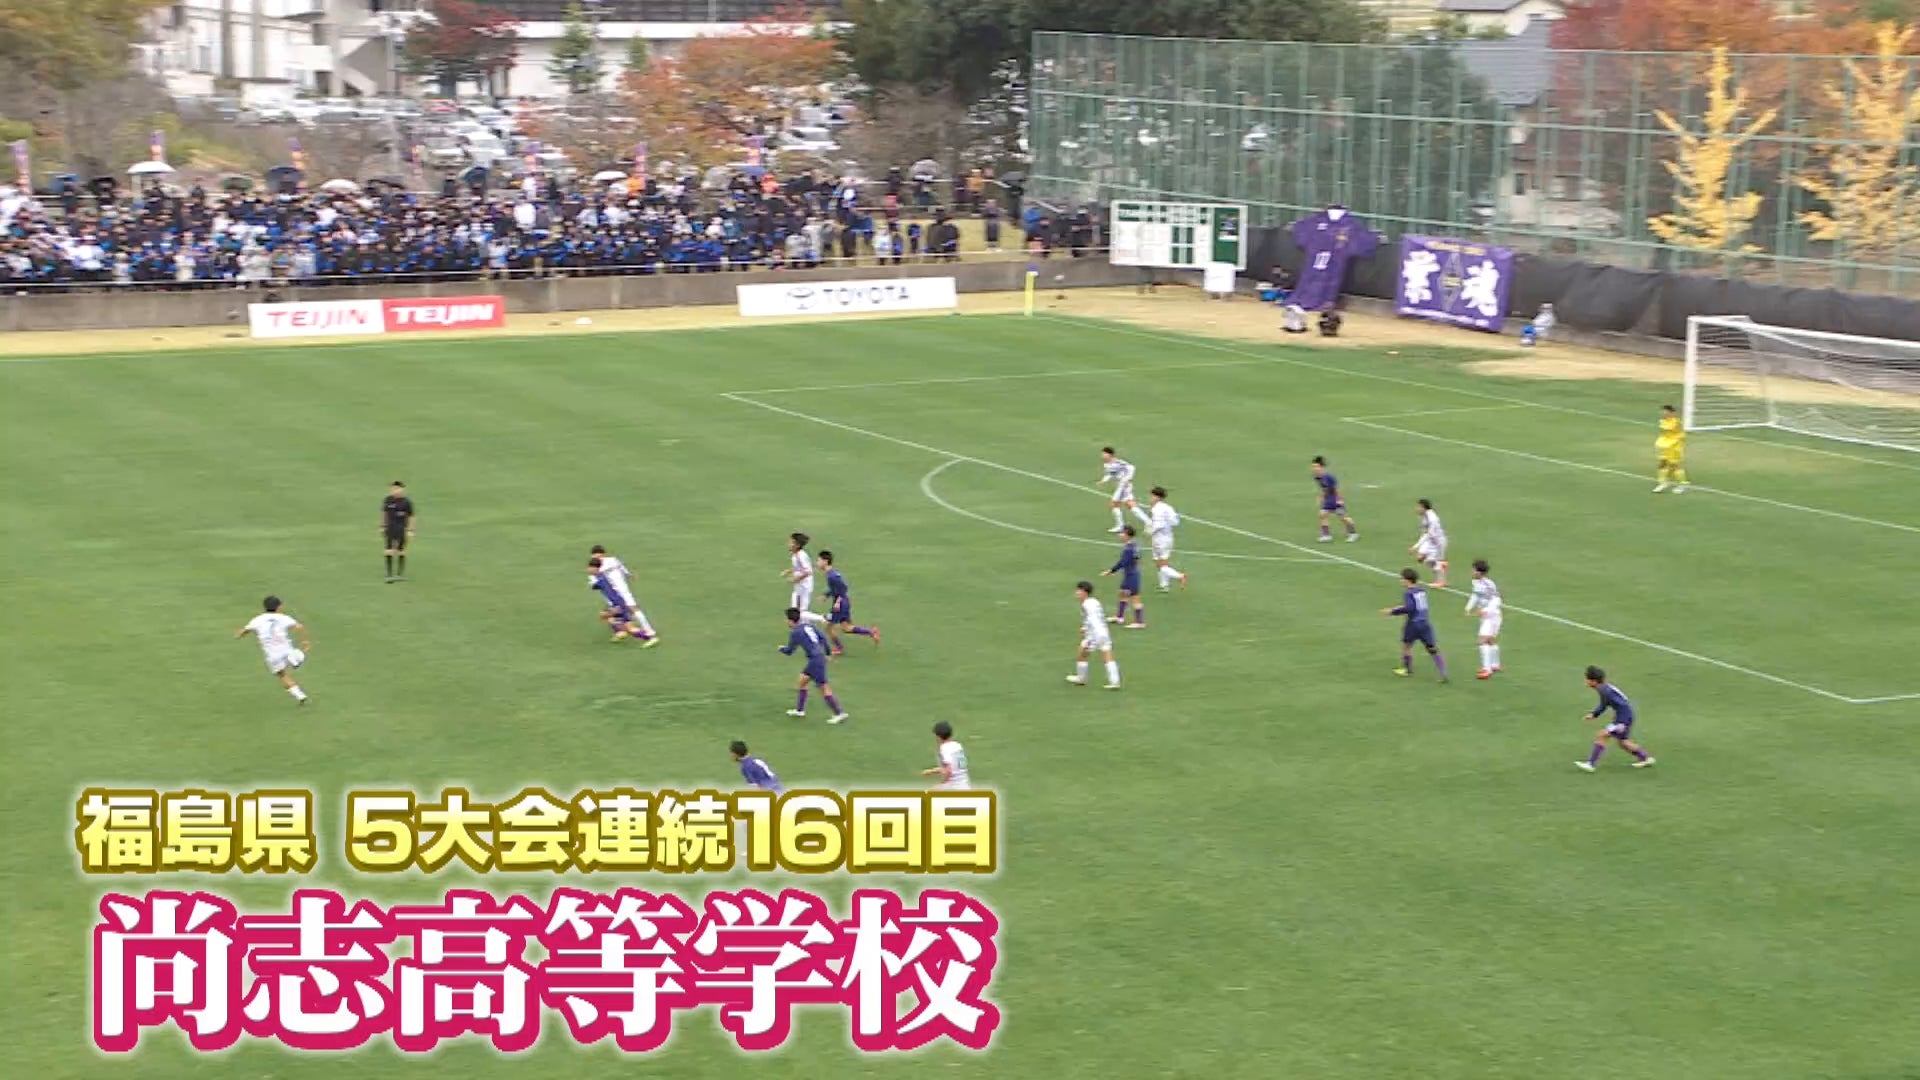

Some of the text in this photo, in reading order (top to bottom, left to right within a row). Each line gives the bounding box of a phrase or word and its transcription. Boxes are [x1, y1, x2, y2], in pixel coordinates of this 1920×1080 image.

[821, 285, 911, 306] TOYOTA
[265, 308, 369, 329] TEIJIN
[389, 303, 496, 326] TEIJIN
